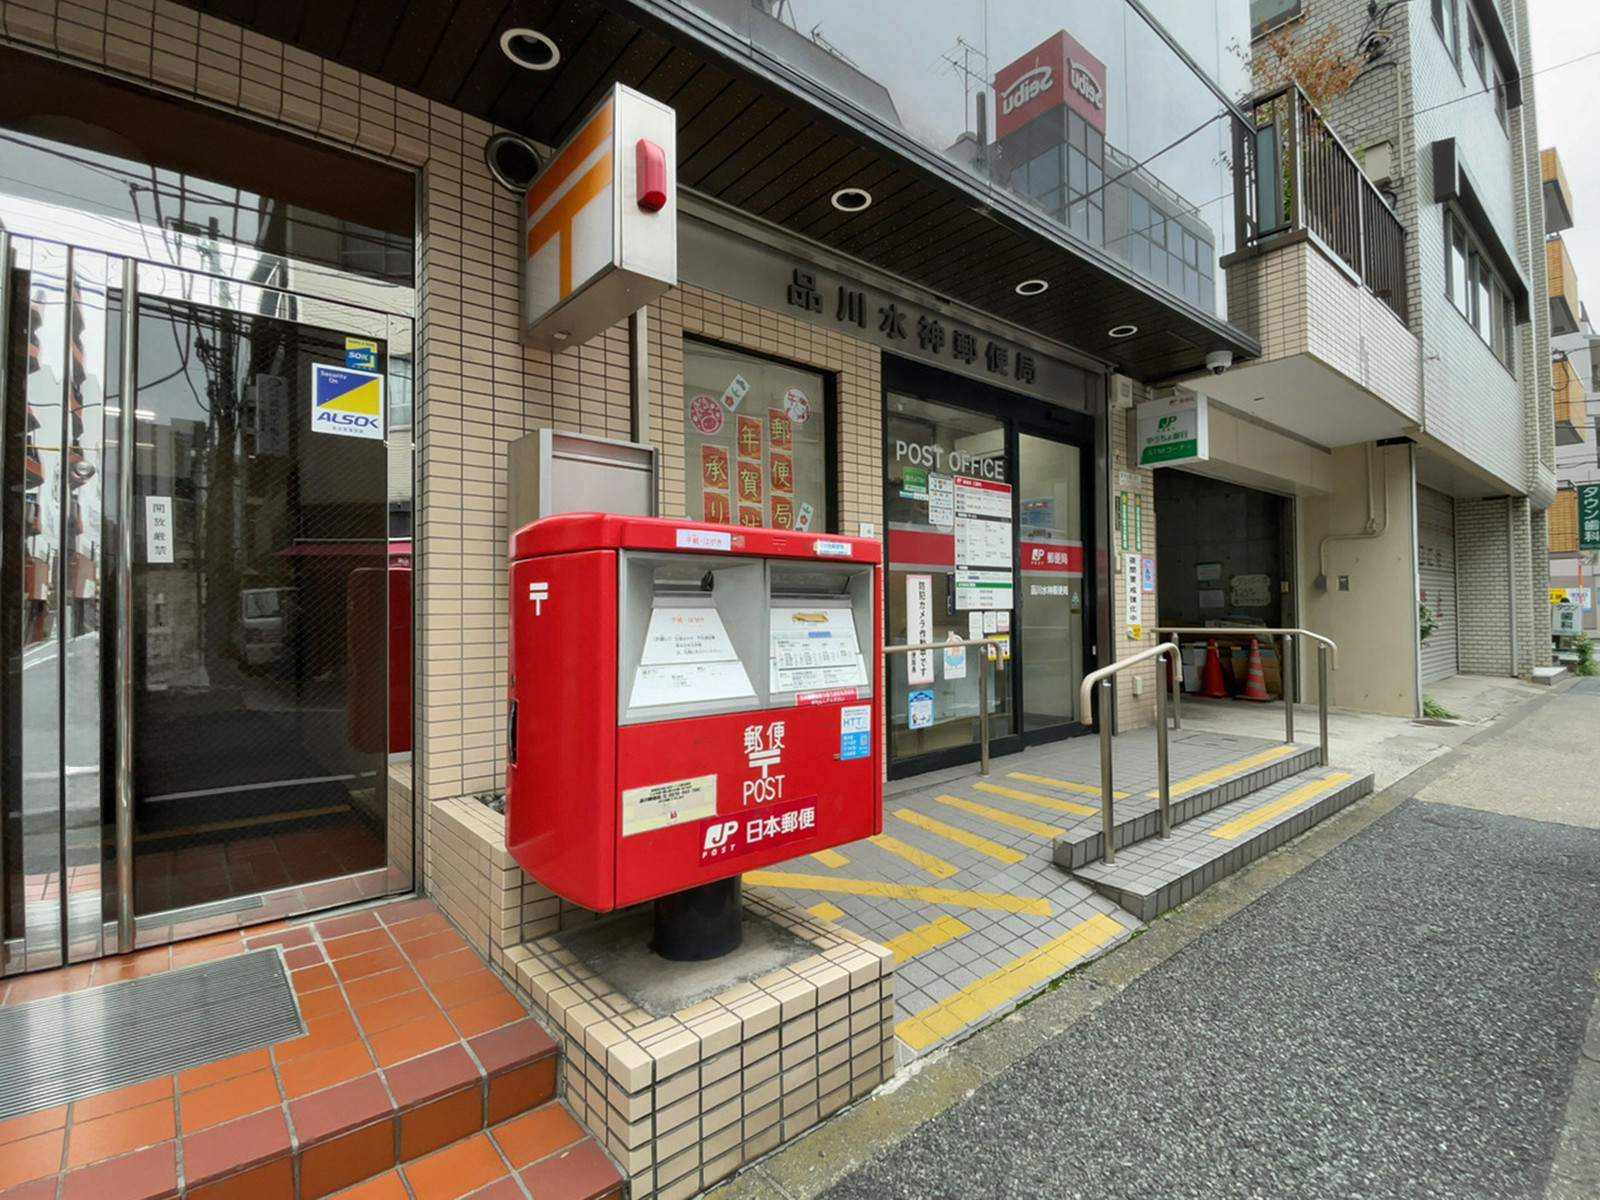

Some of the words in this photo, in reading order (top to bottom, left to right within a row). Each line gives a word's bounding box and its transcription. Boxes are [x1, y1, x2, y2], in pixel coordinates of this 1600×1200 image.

[787, 268, 1038, 384] 品川水神郵便局
[320, 370, 348, 380] Security
[317, 411, 379, 429] ALSOK
[1146, 431, 1188, 444] ゆうちょ銀行
[895, 440, 943, 469] POST
[948, 451, 1005, 480] OFFICE
[705, 455, 727, 524] 承り
[152, 503, 166, 556] 開放厳禁
[1583, 486, 1600, 543] タウン歯科
[1555, 604, 1579, 612] タウン
[743, 720, 786, 754] 郵便
[743, 774, 786, 806] POST
[704, 820, 739, 850] JP
[746, 806, 816, 844] 日本郵便
[702, 844, 737, 860] POST
